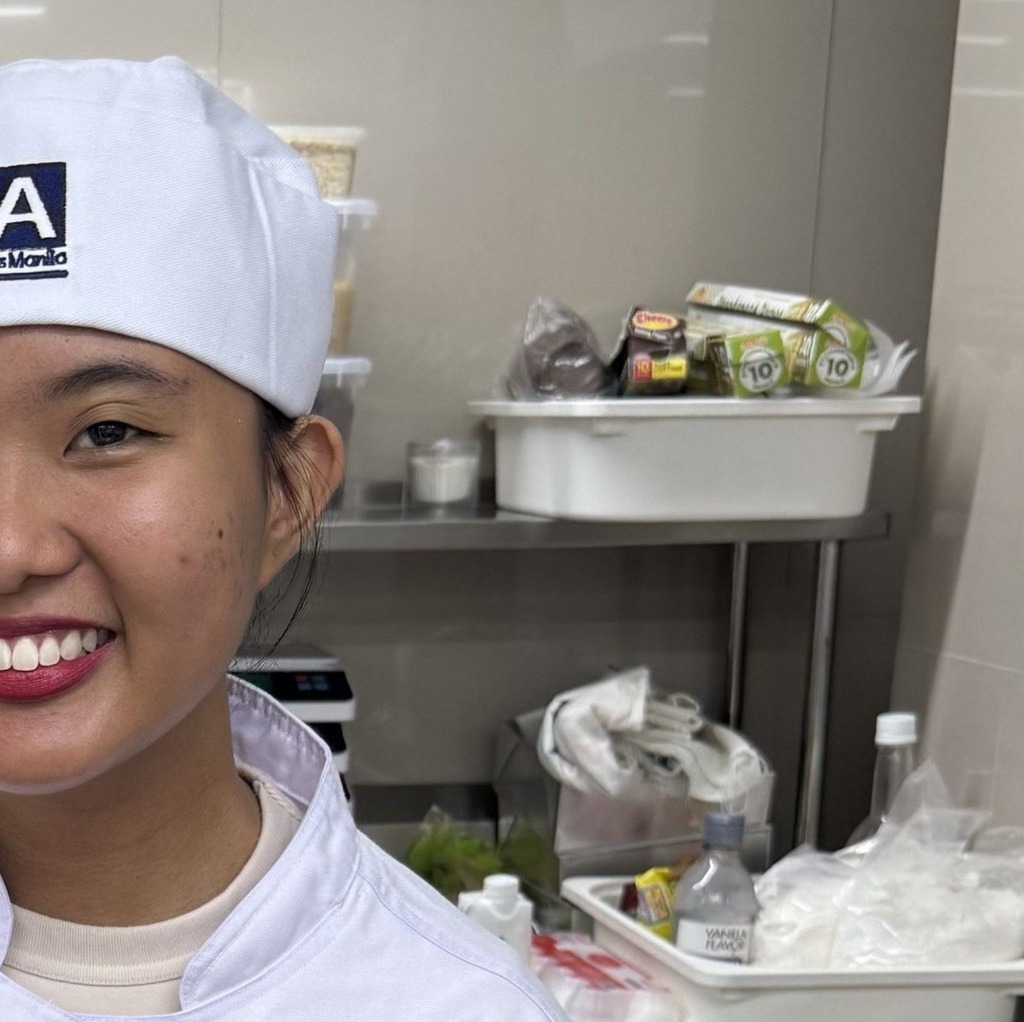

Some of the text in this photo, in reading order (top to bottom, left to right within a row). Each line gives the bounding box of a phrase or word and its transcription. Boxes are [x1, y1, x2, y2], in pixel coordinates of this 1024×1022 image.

[8, 248, 68, 268] Manila
[747, 362, 773, 382] 10
[827, 358, 849, 377] 10
